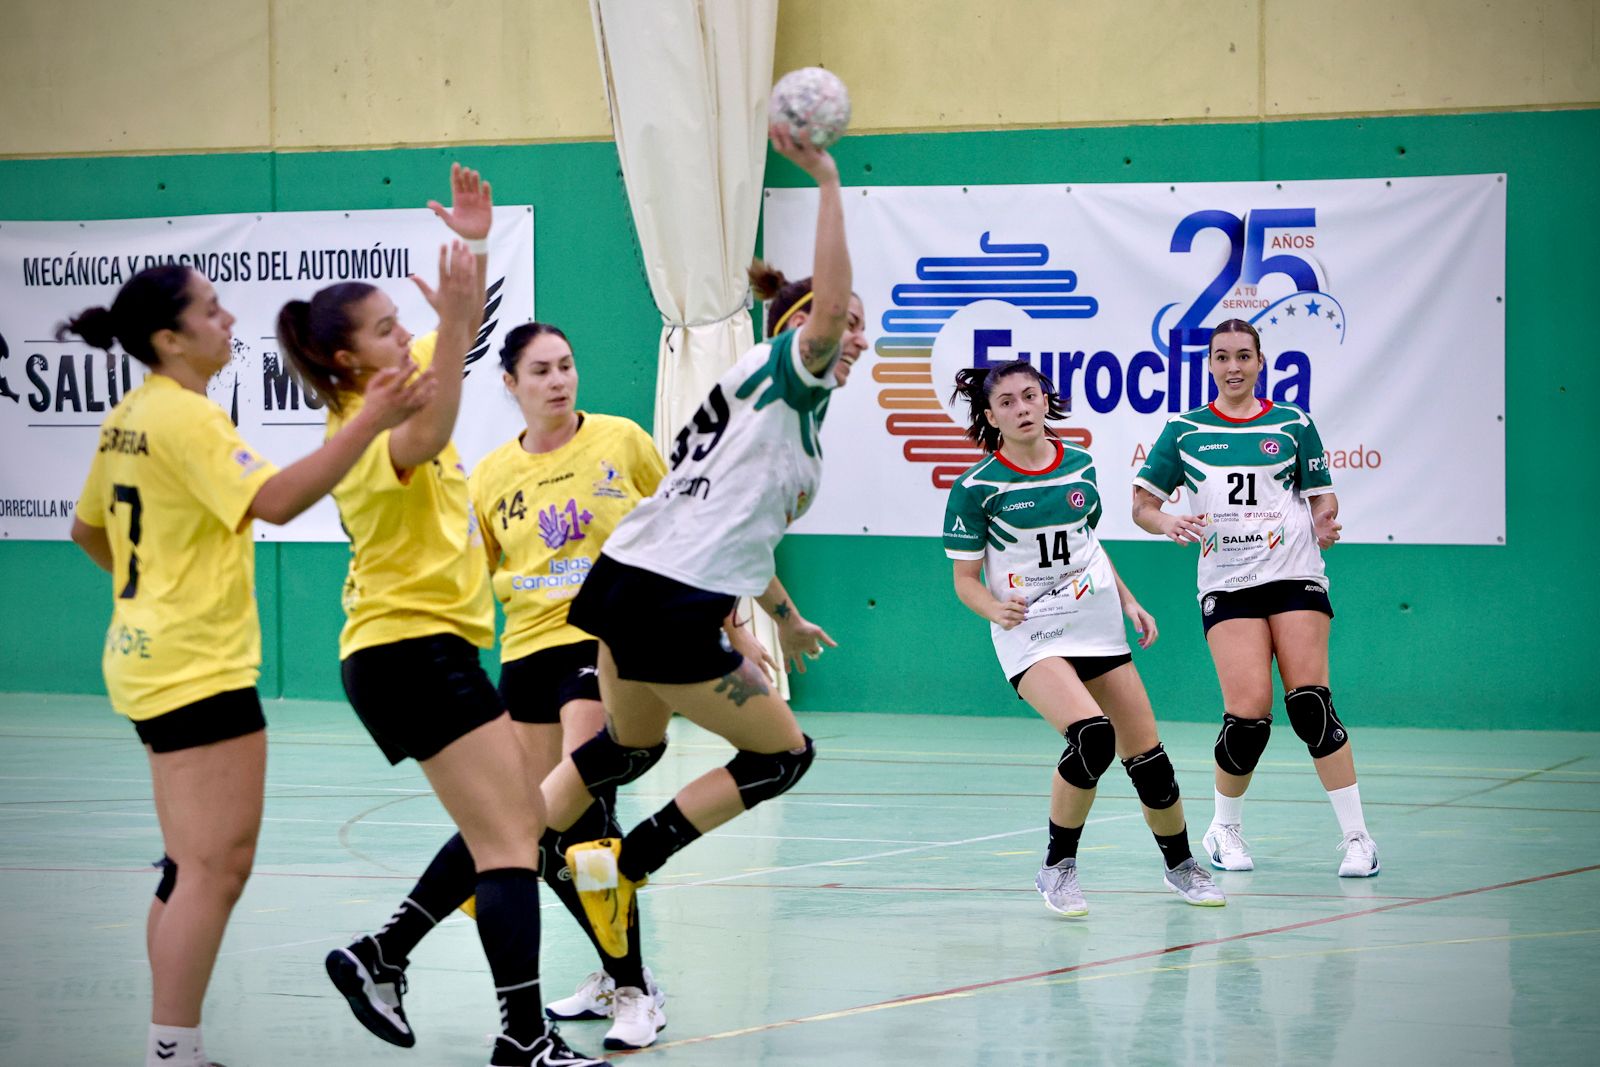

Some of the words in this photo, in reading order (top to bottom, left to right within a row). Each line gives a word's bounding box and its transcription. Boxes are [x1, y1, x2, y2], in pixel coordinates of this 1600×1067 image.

[1271, 233, 1315, 249] AÑOS
[23, 250, 123, 286] MECÁNICA
[127, 255, 140, 280] Y
[257, 251, 293, 281] DEL
[297, 242, 415, 280] AUTOMÓVIL
[1169, 207, 1320, 330] 25
[1222, 299, 1270, 309] SERVICIO
[1235, 287, 1243, 296] A
[1245, 287, 1258, 296] TU
[1227, 473, 1258, 506] 21
[497, 490, 528, 531] 14
[108, 484, 143, 599] 7
[1036, 530, 1071, 569] 14
[1222, 534, 1264, 544] SALMA
[549, 556, 592, 575] Islas
[512, 571, 589, 591] Canarias
